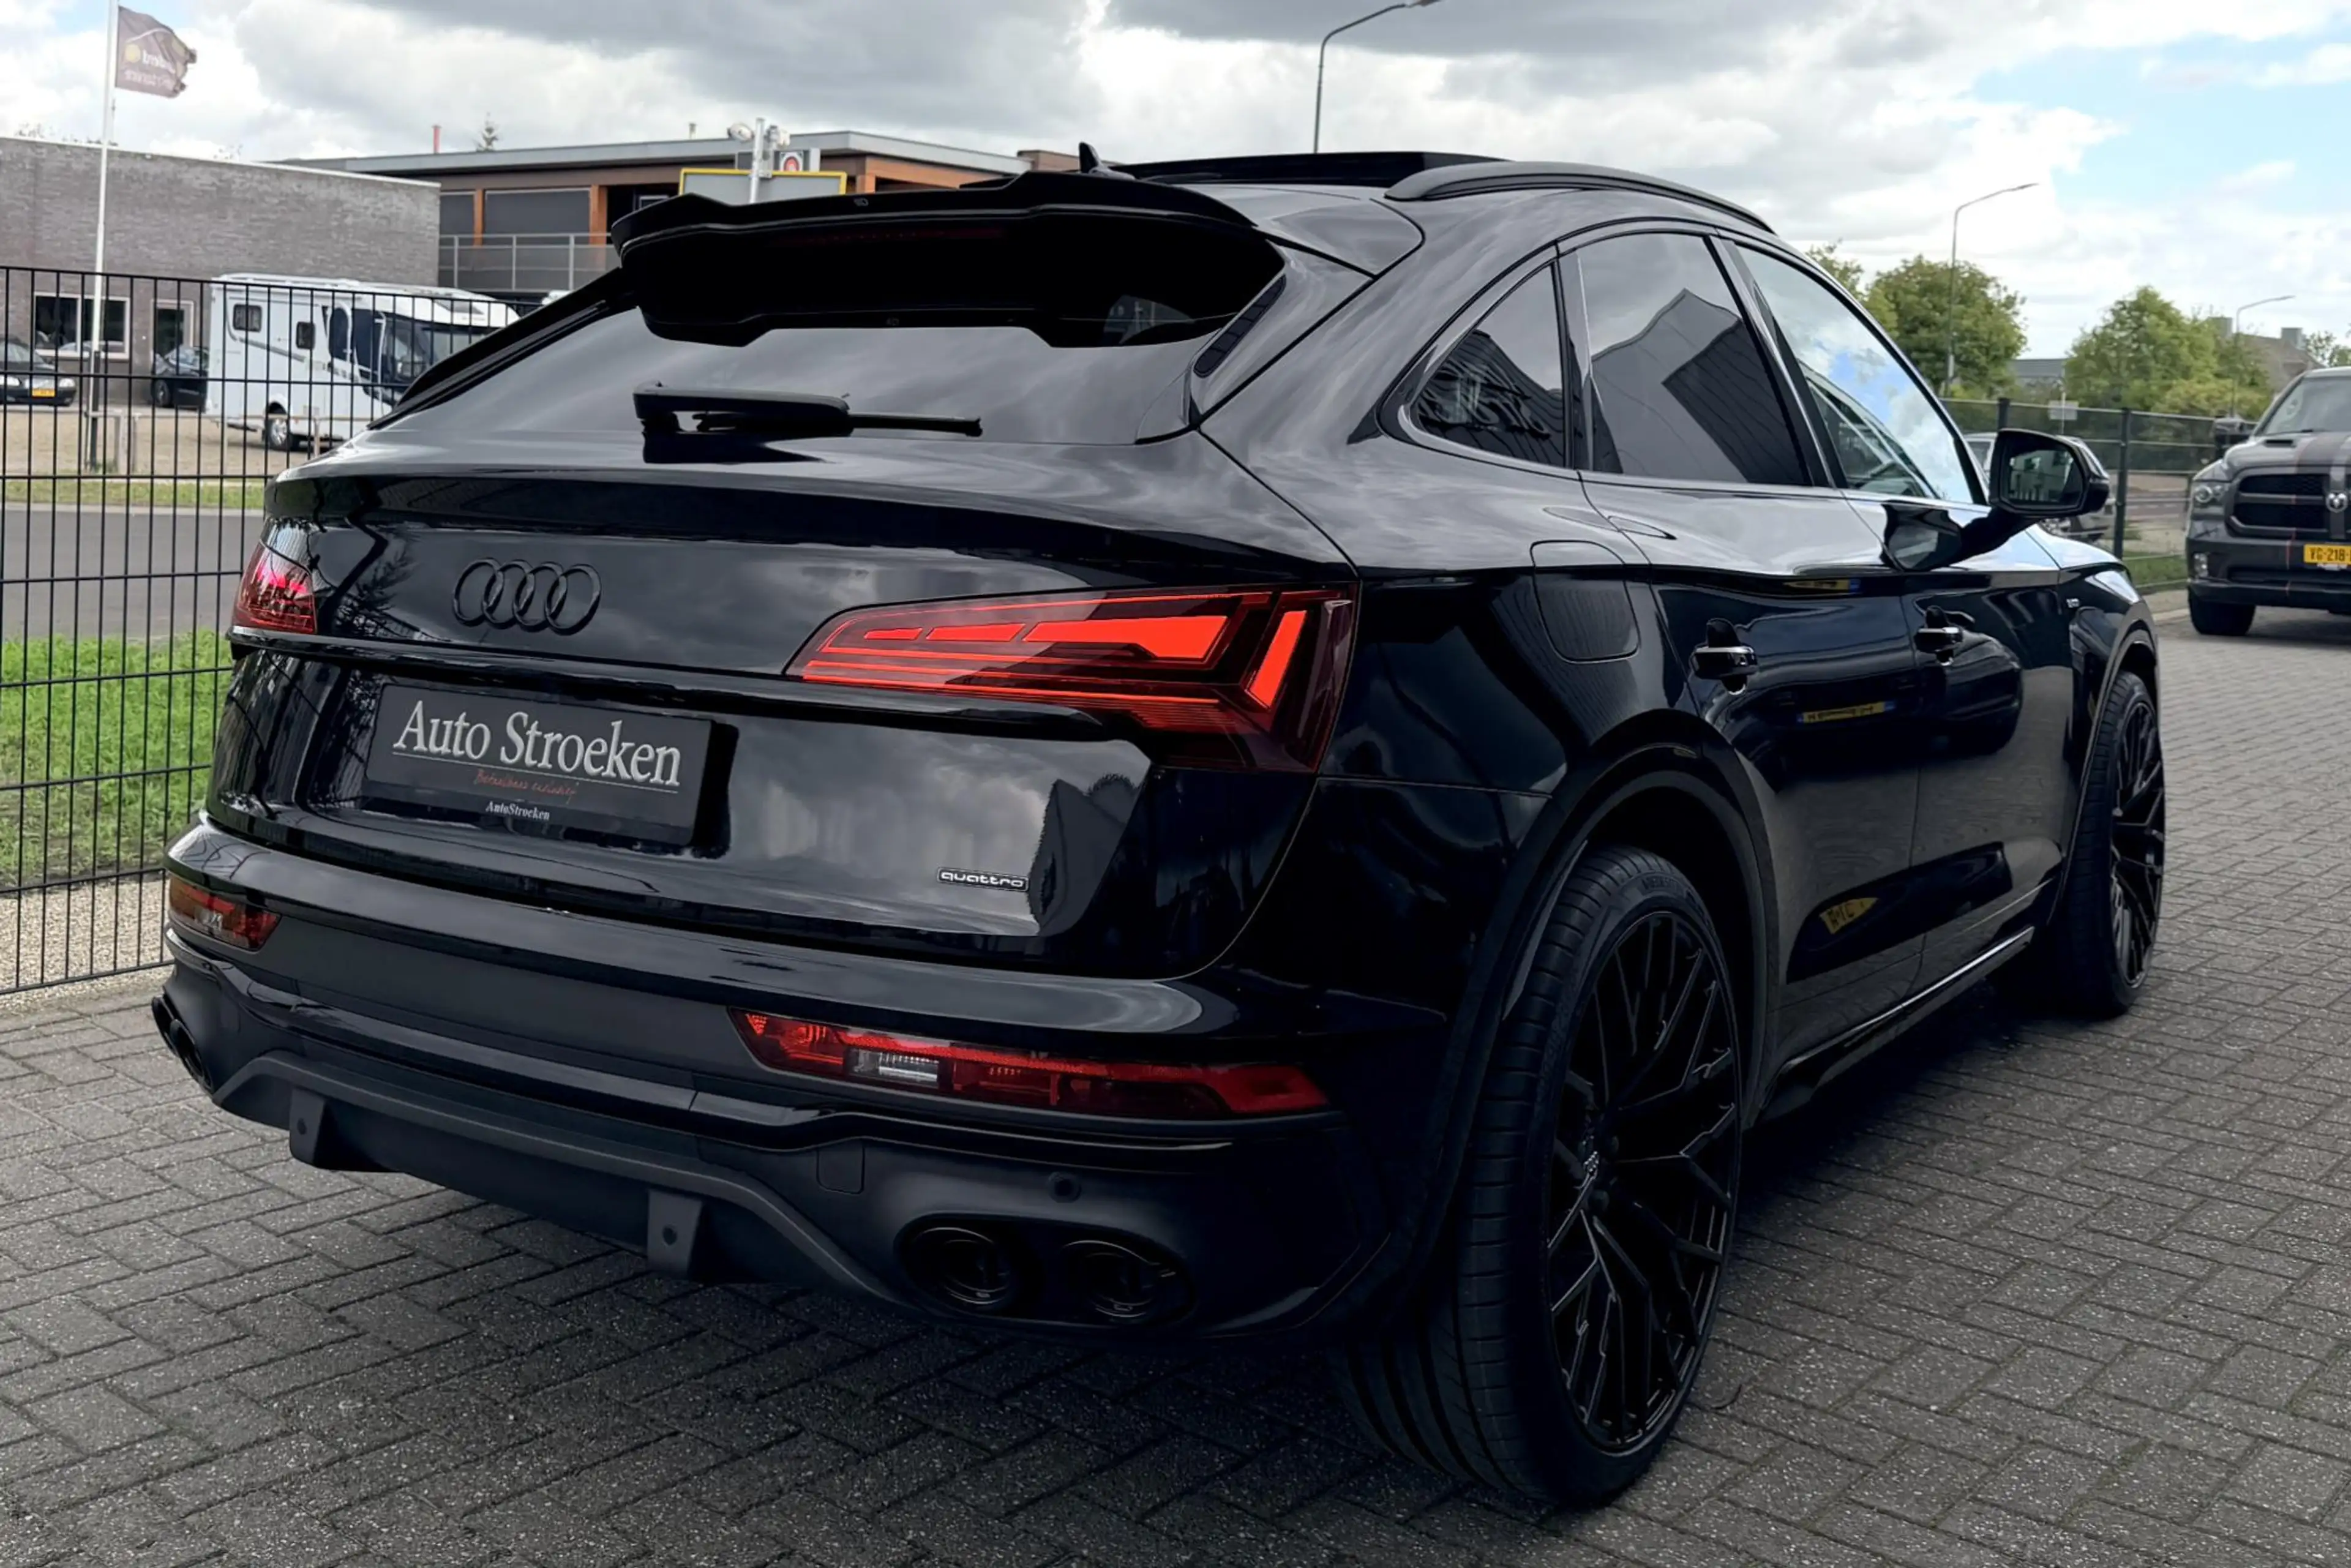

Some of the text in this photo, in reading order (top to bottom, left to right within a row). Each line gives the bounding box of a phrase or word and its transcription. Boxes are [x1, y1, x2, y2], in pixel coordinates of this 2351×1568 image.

[2309, 547, 2351, 562] VG-218-
[392, 699, 491, 760] Auto
[500, 711, 681, 787] Stroeken
[486, 800, 550, 820] AutoStroeken
[940, 871, 1024, 888] quattro
